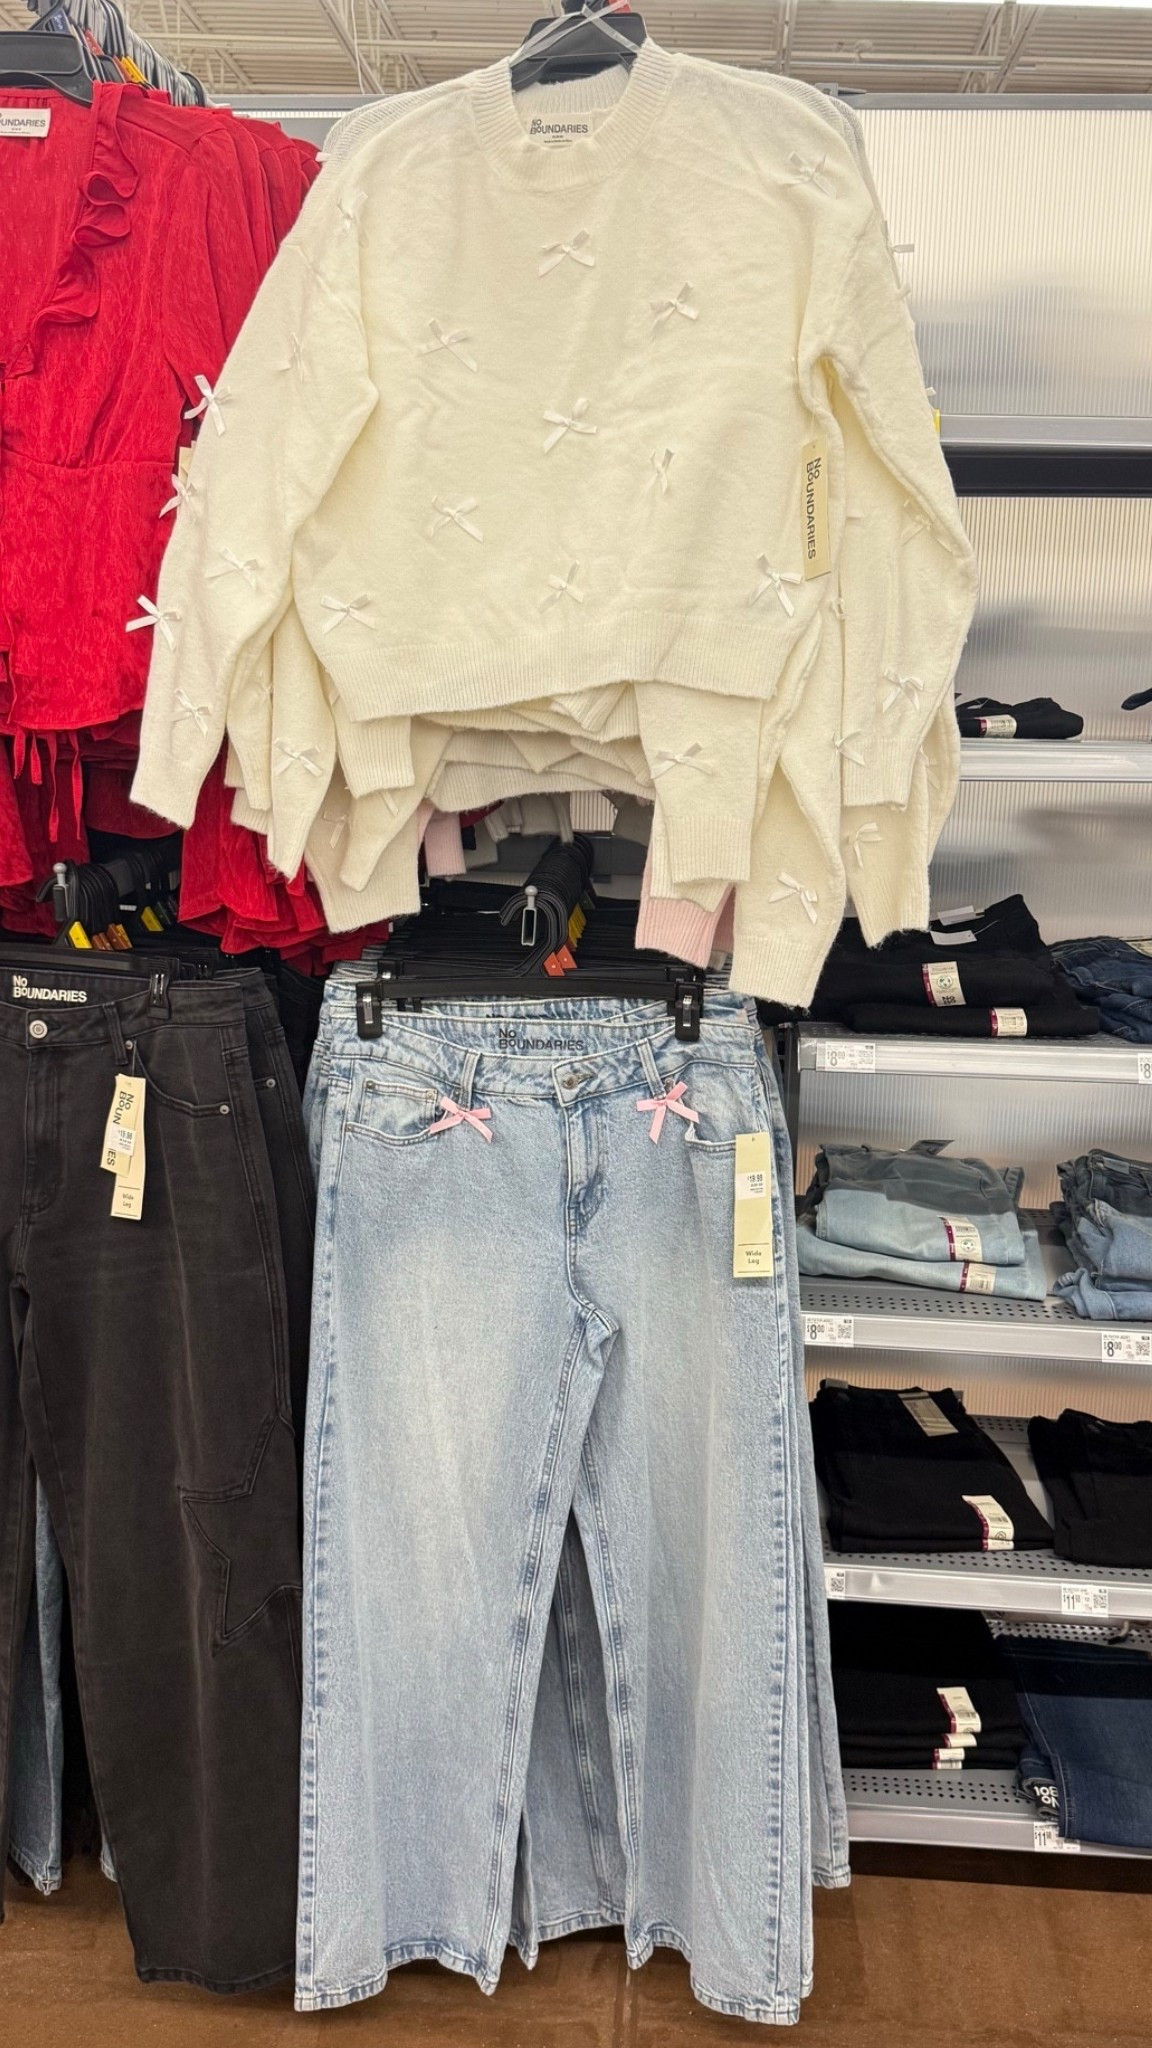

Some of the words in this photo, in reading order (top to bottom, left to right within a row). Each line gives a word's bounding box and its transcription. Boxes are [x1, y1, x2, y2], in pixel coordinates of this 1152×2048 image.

[0, 118, 46, 127] UNDARIES
[530, 124, 588, 134] BOUNDARIES
[806, 461, 817, 560] BOUNDARIES
[499, 1039, 584, 1051] BOUNDARIES
[1140, 1062, 1152, 1079] $8
[748, 1257, 760, 1265] Leg
